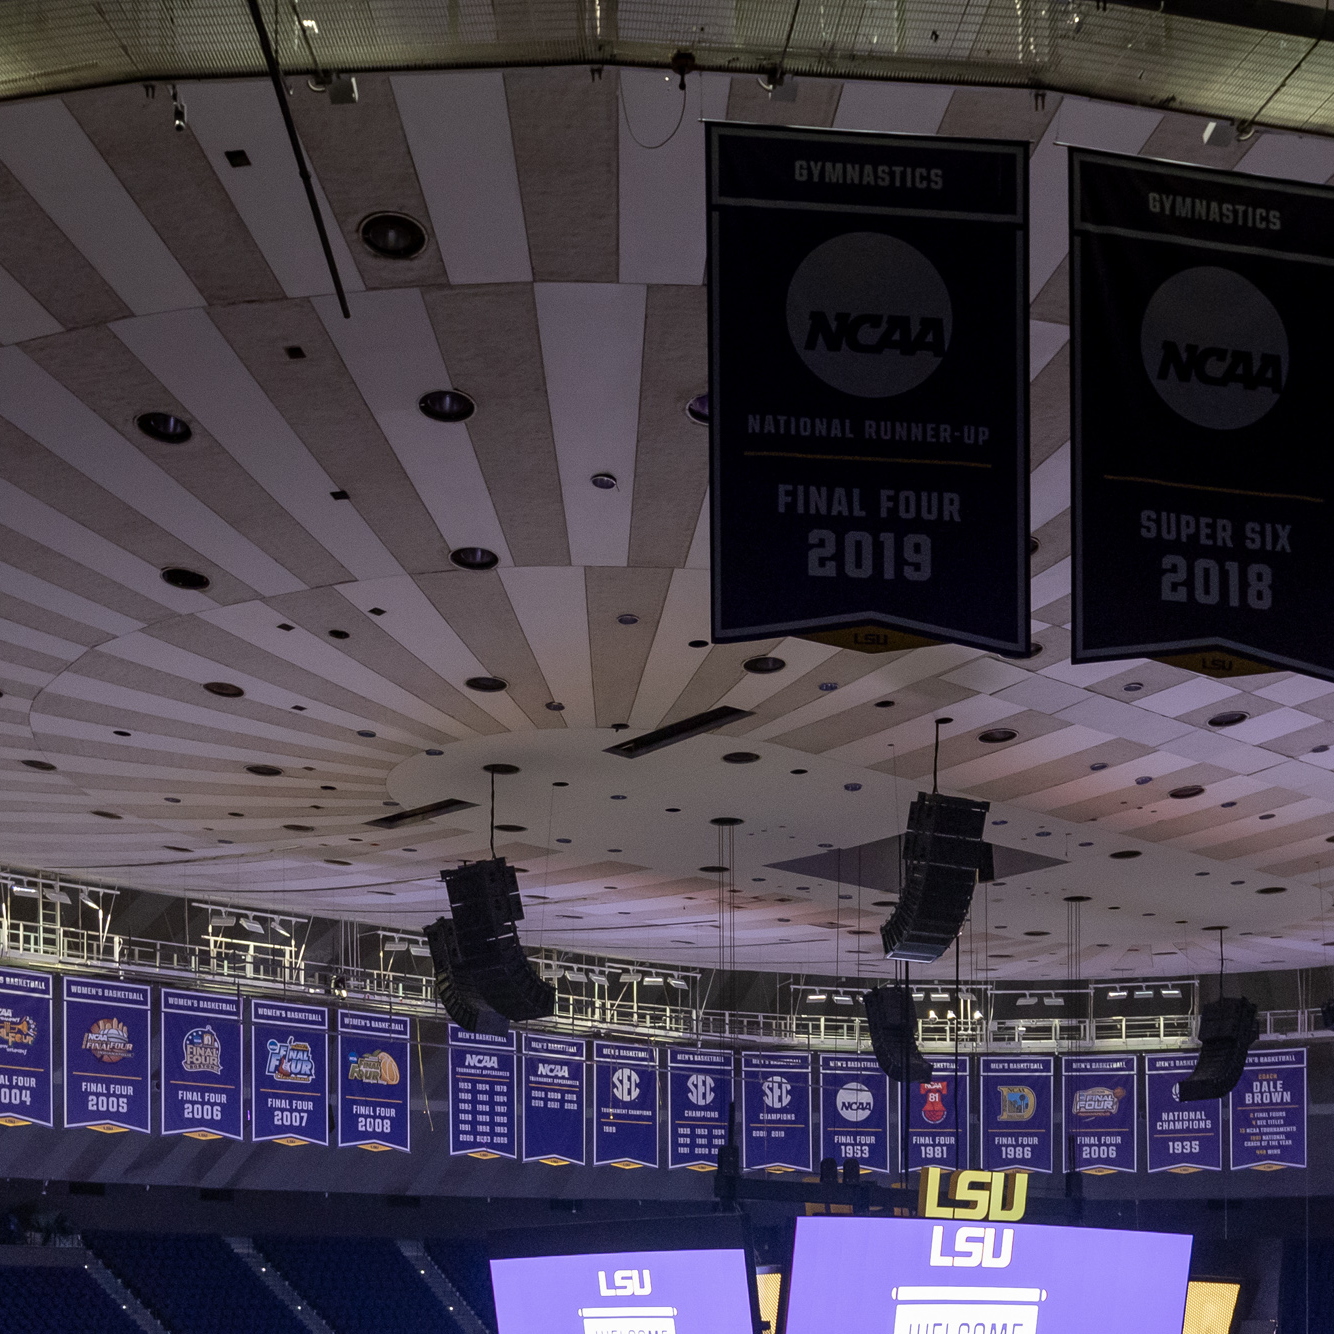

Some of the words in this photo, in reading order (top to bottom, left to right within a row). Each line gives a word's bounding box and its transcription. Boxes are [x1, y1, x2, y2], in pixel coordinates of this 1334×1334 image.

[794, 159, 944, 191] GYMNASTICS
[1147, 192, 1282, 231] GYMNASTICS
[805, 311, 946, 357] NCAA
[1157, 342, 1283, 394] NCAA
[746, 413, 855, 439] NATIONAL
[863, 418, 990, 446] RUNNER-UP
[776, 483, 866, 518] FINAL
[878, 487, 961, 522] FOUR
[1139, 509, 1233, 548] SUPER
[1244, 520, 1293, 554] SIX
[806, 529, 932, 582] 2019
[1159, 555, 1274, 610] 2018
[854, 633, 888, 647] LSU
[1201, 658, 1233, 672] LSU
[6, 977, 45, 989] BASKETBALL
[71, 985, 102, 996] WOMEN'S
[104, 989, 144, 1000] BASKETBALL
[168, 997, 198, 1007] WOMEN'S
[200, 1000, 237, 1012] BASKETBALL
[258, 1007, 286, 1018] WOMEN'S
[287, 1011, 322, 1021] BASKETBALL
[344, 1017, 371, 1028] WOMEN'S
[458, 1032, 475, 1040] MEN'S
[87, 1042, 110, 1050] FINAL
[187, 1045, 218, 1057] FINAL
[187, 1054, 217, 1065] FOUR
[465, 1054, 498, 1068] NCAA
[1260, 1055, 1295, 1063] BASKETBALL
[538, 1064, 569, 1077] NCAA
[13, 1076, 36, 1088] FOUR
[82, 1082, 107, 1093] FINAL
[110, 1085, 133, 1095] FOUR
[613, 1068, 640, 1101] SEC
[1253, 1081, 1283, 1092] DALE
[687, 1074, 715, 1105] SEC
[762, 1076, 791, 1108] SEC
[88, 1096, 127, 1112] 2005
[179, 1091, 202, 1102] FINAL
[205, 1092, 227, 1104] FOUR
[1245, 1092, 1290, 1104] BROWN
[268, 1099, 290, 1109] FINAL
[293, 1100, 313, 1110] FOUR
[353, 1105, 374, 1115] FINAL
[376, 1107, 396, 1117] FOUR
[841, 1102, 872, 1111] NCAA
[1077, 1101, 1113, 1109] FOUR
[184, 1104, 221, 1120] 2006
[1162, 1111, 1206, 1120] NATIONAL
[274, 1111, 308, 1127] 2007
[358, 1118, 391, 1133] 2008
[1157, 1120, 1211, 1130] CHAMPIONS
[835, 1136, 854, 1144] FINAL
[857, 1136, 875, 1144] FOUR
[1101, 1136, 1121, 1144] FOUR
[841, 1145, 869, 1158] 1953
[921, 1146, 947, 1158] 1981
[1002, 1147, 1031, 1158] 1986
[1083, 1147, 1116, 1158] 2006
[1169, 1141, 1199, 1153] 1935
[919, 1168, 1026, 1221] LSU
[930, 1226, 1013, 1268] LSU
[598, 1269, 652, 1297] LSU
